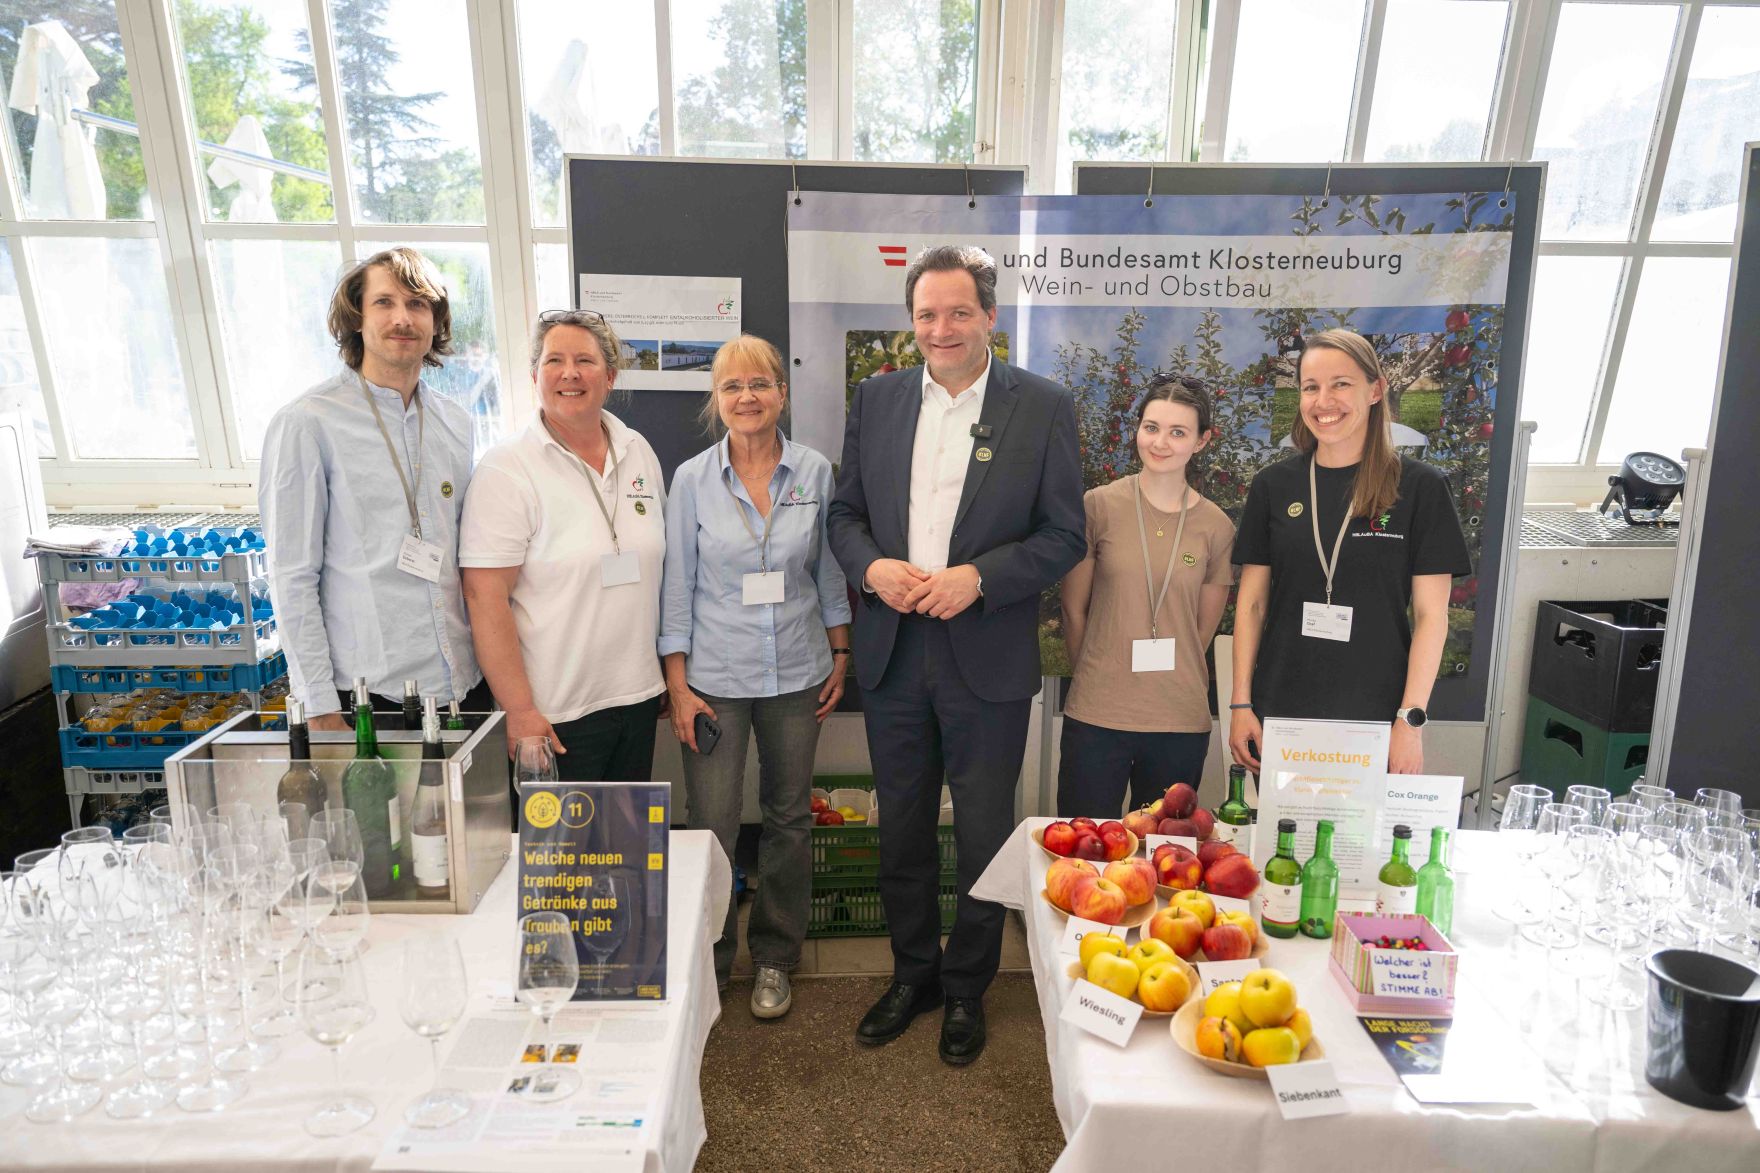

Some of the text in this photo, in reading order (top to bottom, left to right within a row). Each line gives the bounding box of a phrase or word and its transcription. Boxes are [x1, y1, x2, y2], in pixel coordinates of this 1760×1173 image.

[1003, 246, 1402, 275] und Bundesamt Klosterneuburg
[1021, 273, 1272, 298] Wein- und Obstbau
[1281, 748, 1371, 767] Verkostung
[1387, 790, 1439, 801] Cox Orange
[568, 803, 582, 817] 11
[524, 851, 623, 865] Welche neuen
[523, 873, 593, 891] trendigen
[523, 896, 617, 910] Getränke aus
[584, 918, 612, 936] gibt
[526, 940, 548, 954] es?
[1374, 955, 1414, 967] Welcher
[1380, 983, 1443, 998] STIMME AB!
[1079, 995, 1126, 1026] Wiesling
[1278, 1088, 1343, 1103] Siebenkant
